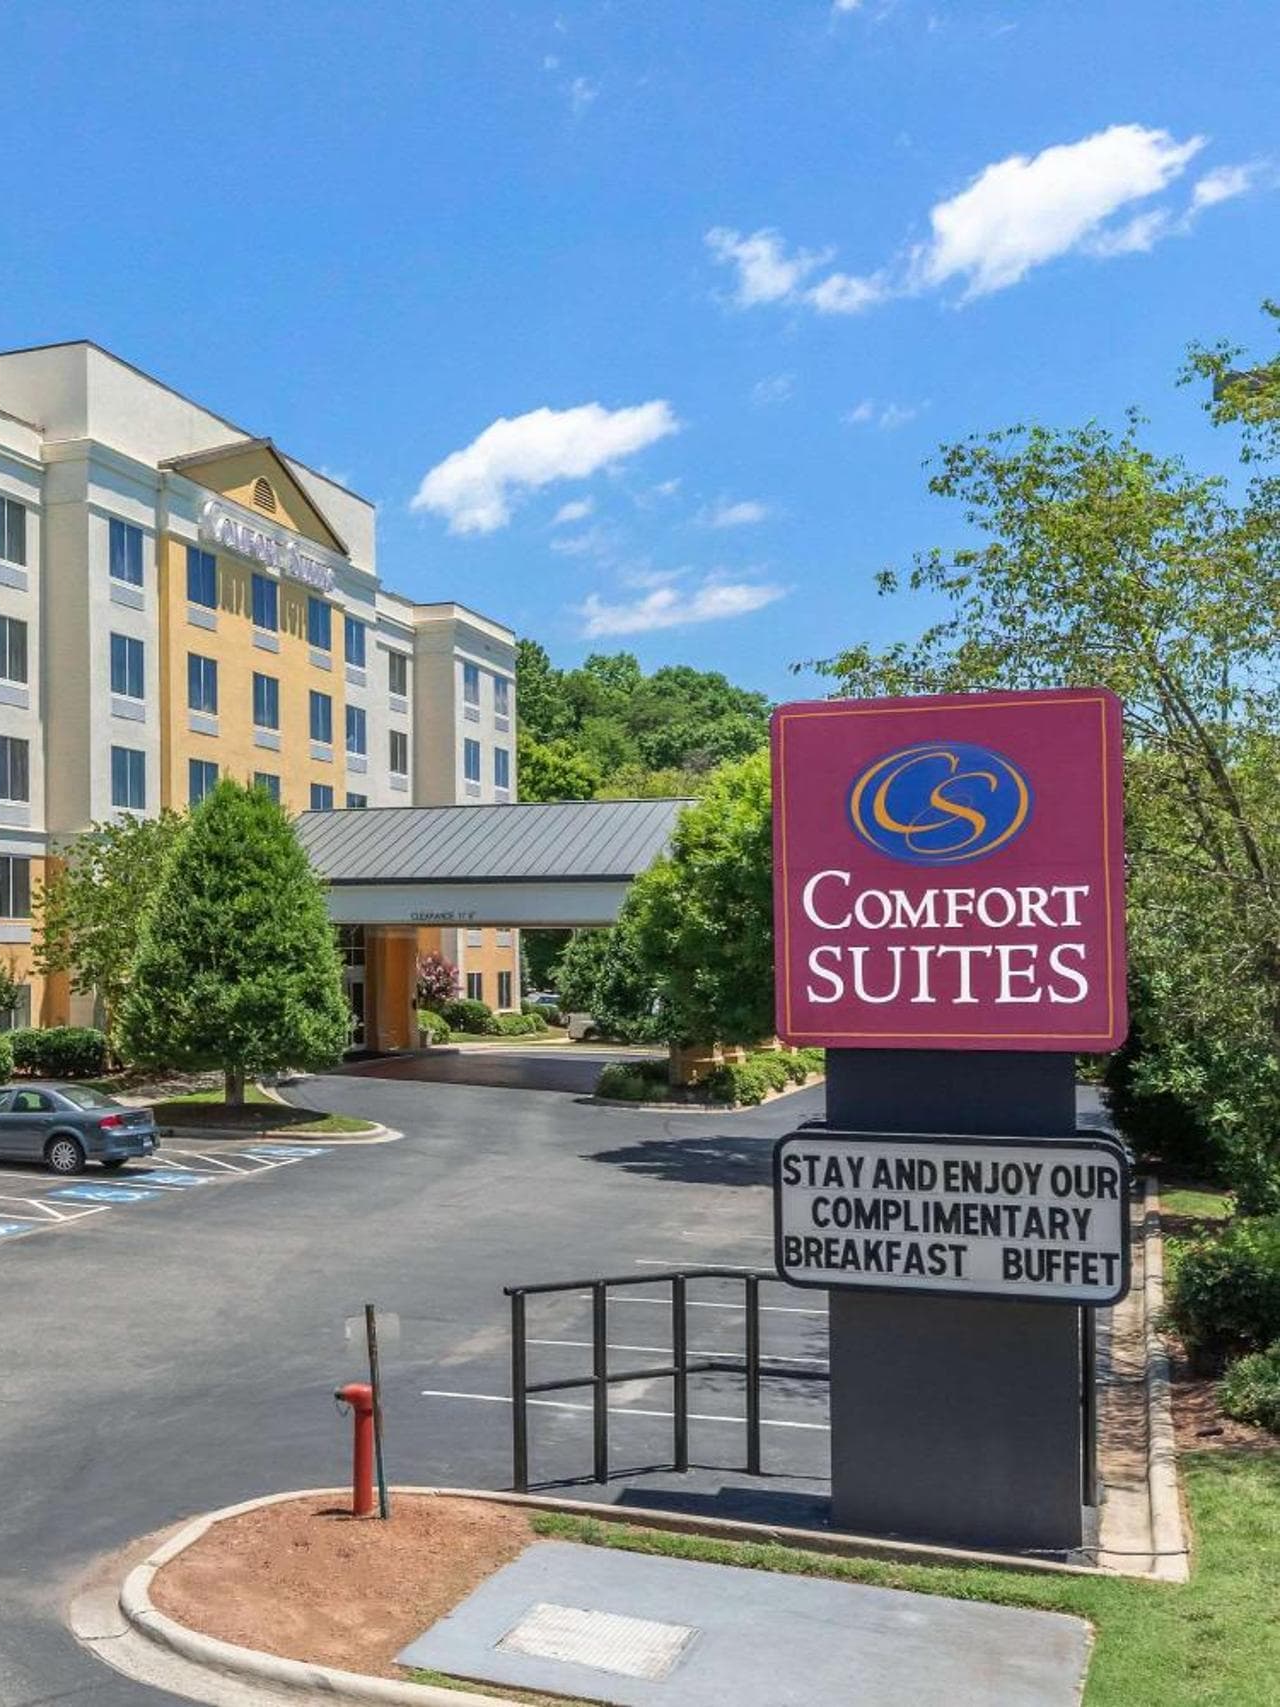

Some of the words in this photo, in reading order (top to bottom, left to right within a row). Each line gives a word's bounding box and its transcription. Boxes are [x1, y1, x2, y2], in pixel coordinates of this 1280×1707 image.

[802, 869, 1090, 930] COMFORT
[806, 943, 1089, 1004] SUITES
[783, 1154, 864, 1188] STAY
[872, 1157, 938, 1191] AND
[943, 1160, 1043, 1196] ENJOY
[1050, 1164, 1118, 1200] OUR
[812, 1196, 1092, 1241] COMPLIMENTARY
[784, 1235, 968, 1277] BREAKFAST
[1002, 1247, 1120, 1286] BUFFET
